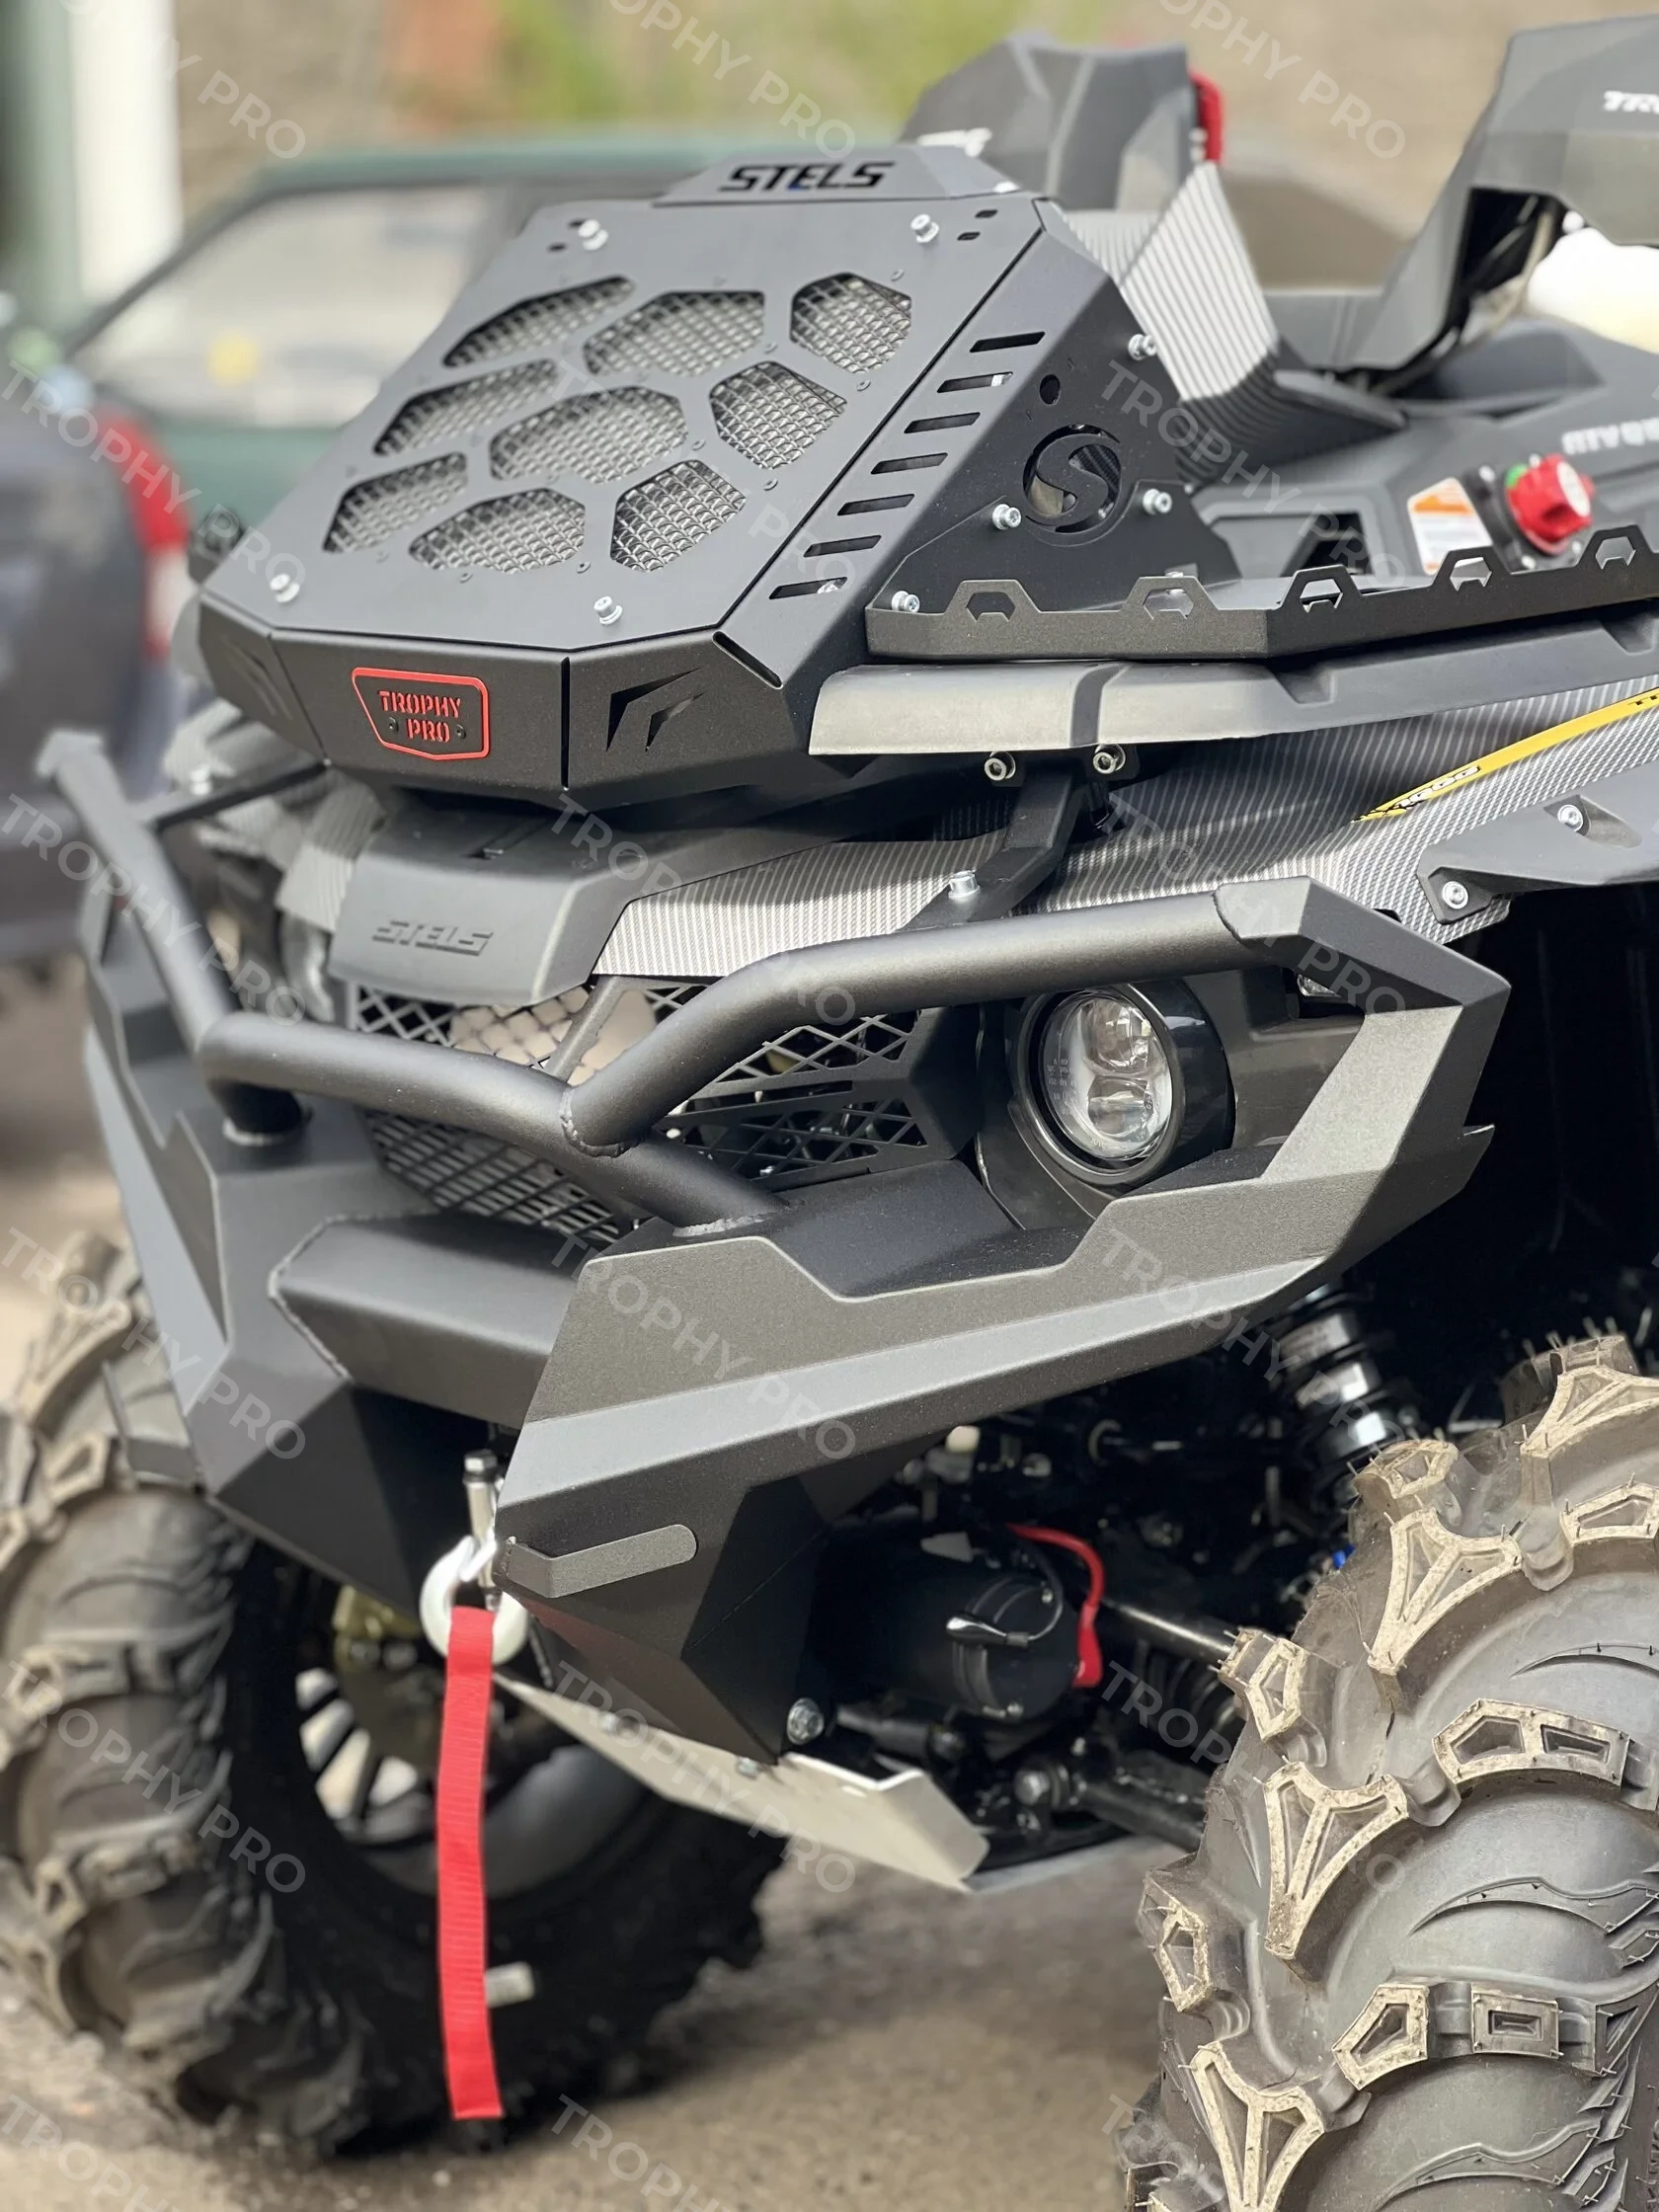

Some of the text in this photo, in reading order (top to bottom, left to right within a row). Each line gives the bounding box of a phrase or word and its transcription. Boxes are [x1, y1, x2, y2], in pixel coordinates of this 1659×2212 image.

[718, 162, 896, 192] STELS
[378, 690, 461, 719] TROPHY
[407, 718, 450, 743] PRO
[371, 918, 494, 956] STELS
